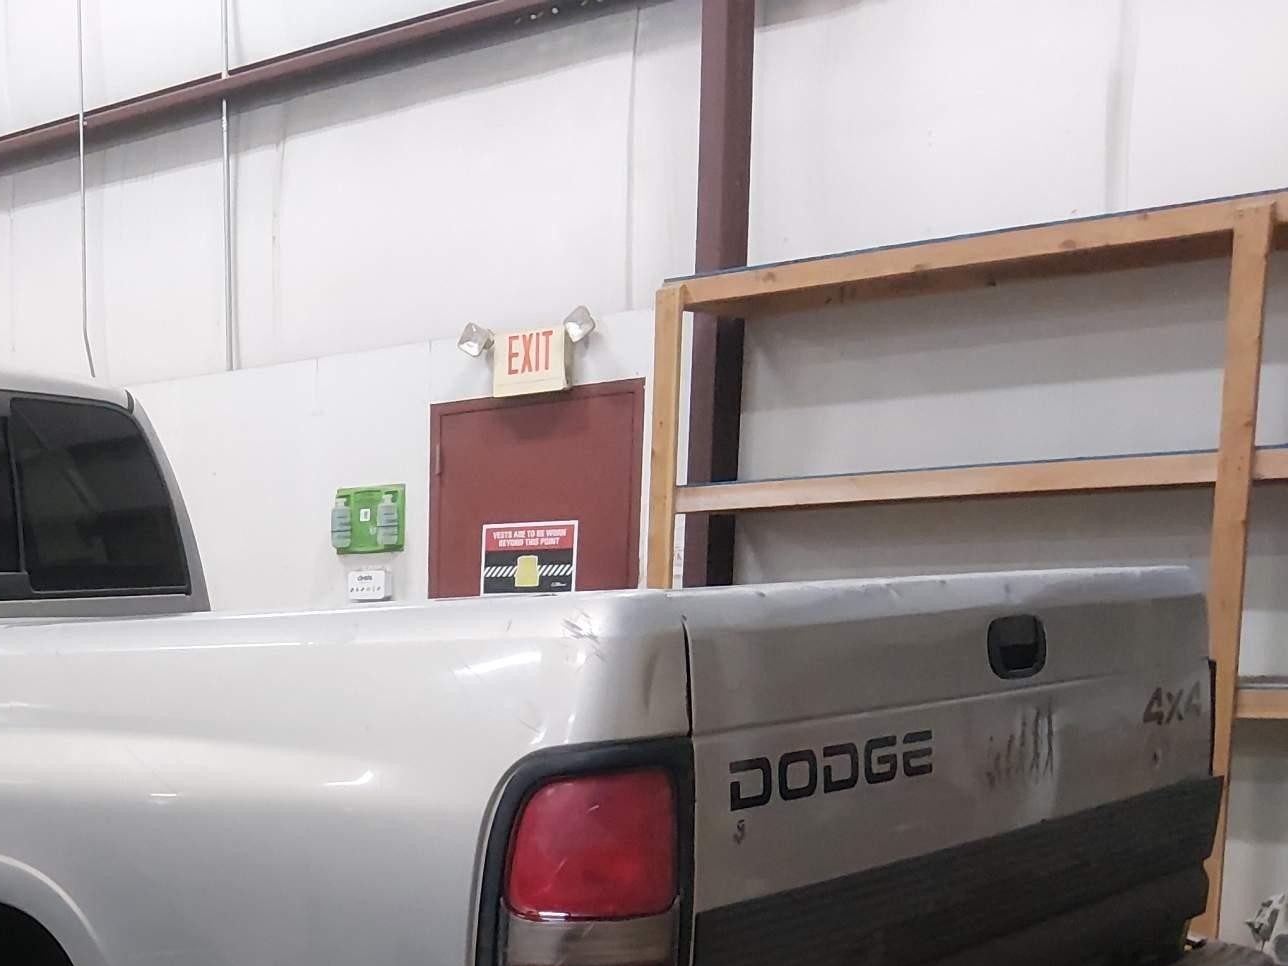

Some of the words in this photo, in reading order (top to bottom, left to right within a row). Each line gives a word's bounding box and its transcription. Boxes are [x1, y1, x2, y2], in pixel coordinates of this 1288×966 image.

[507, 329, 554, 376] EXIT
[526, 529, 536, 538] TO
[729, 729, 933, 812] DODGE
